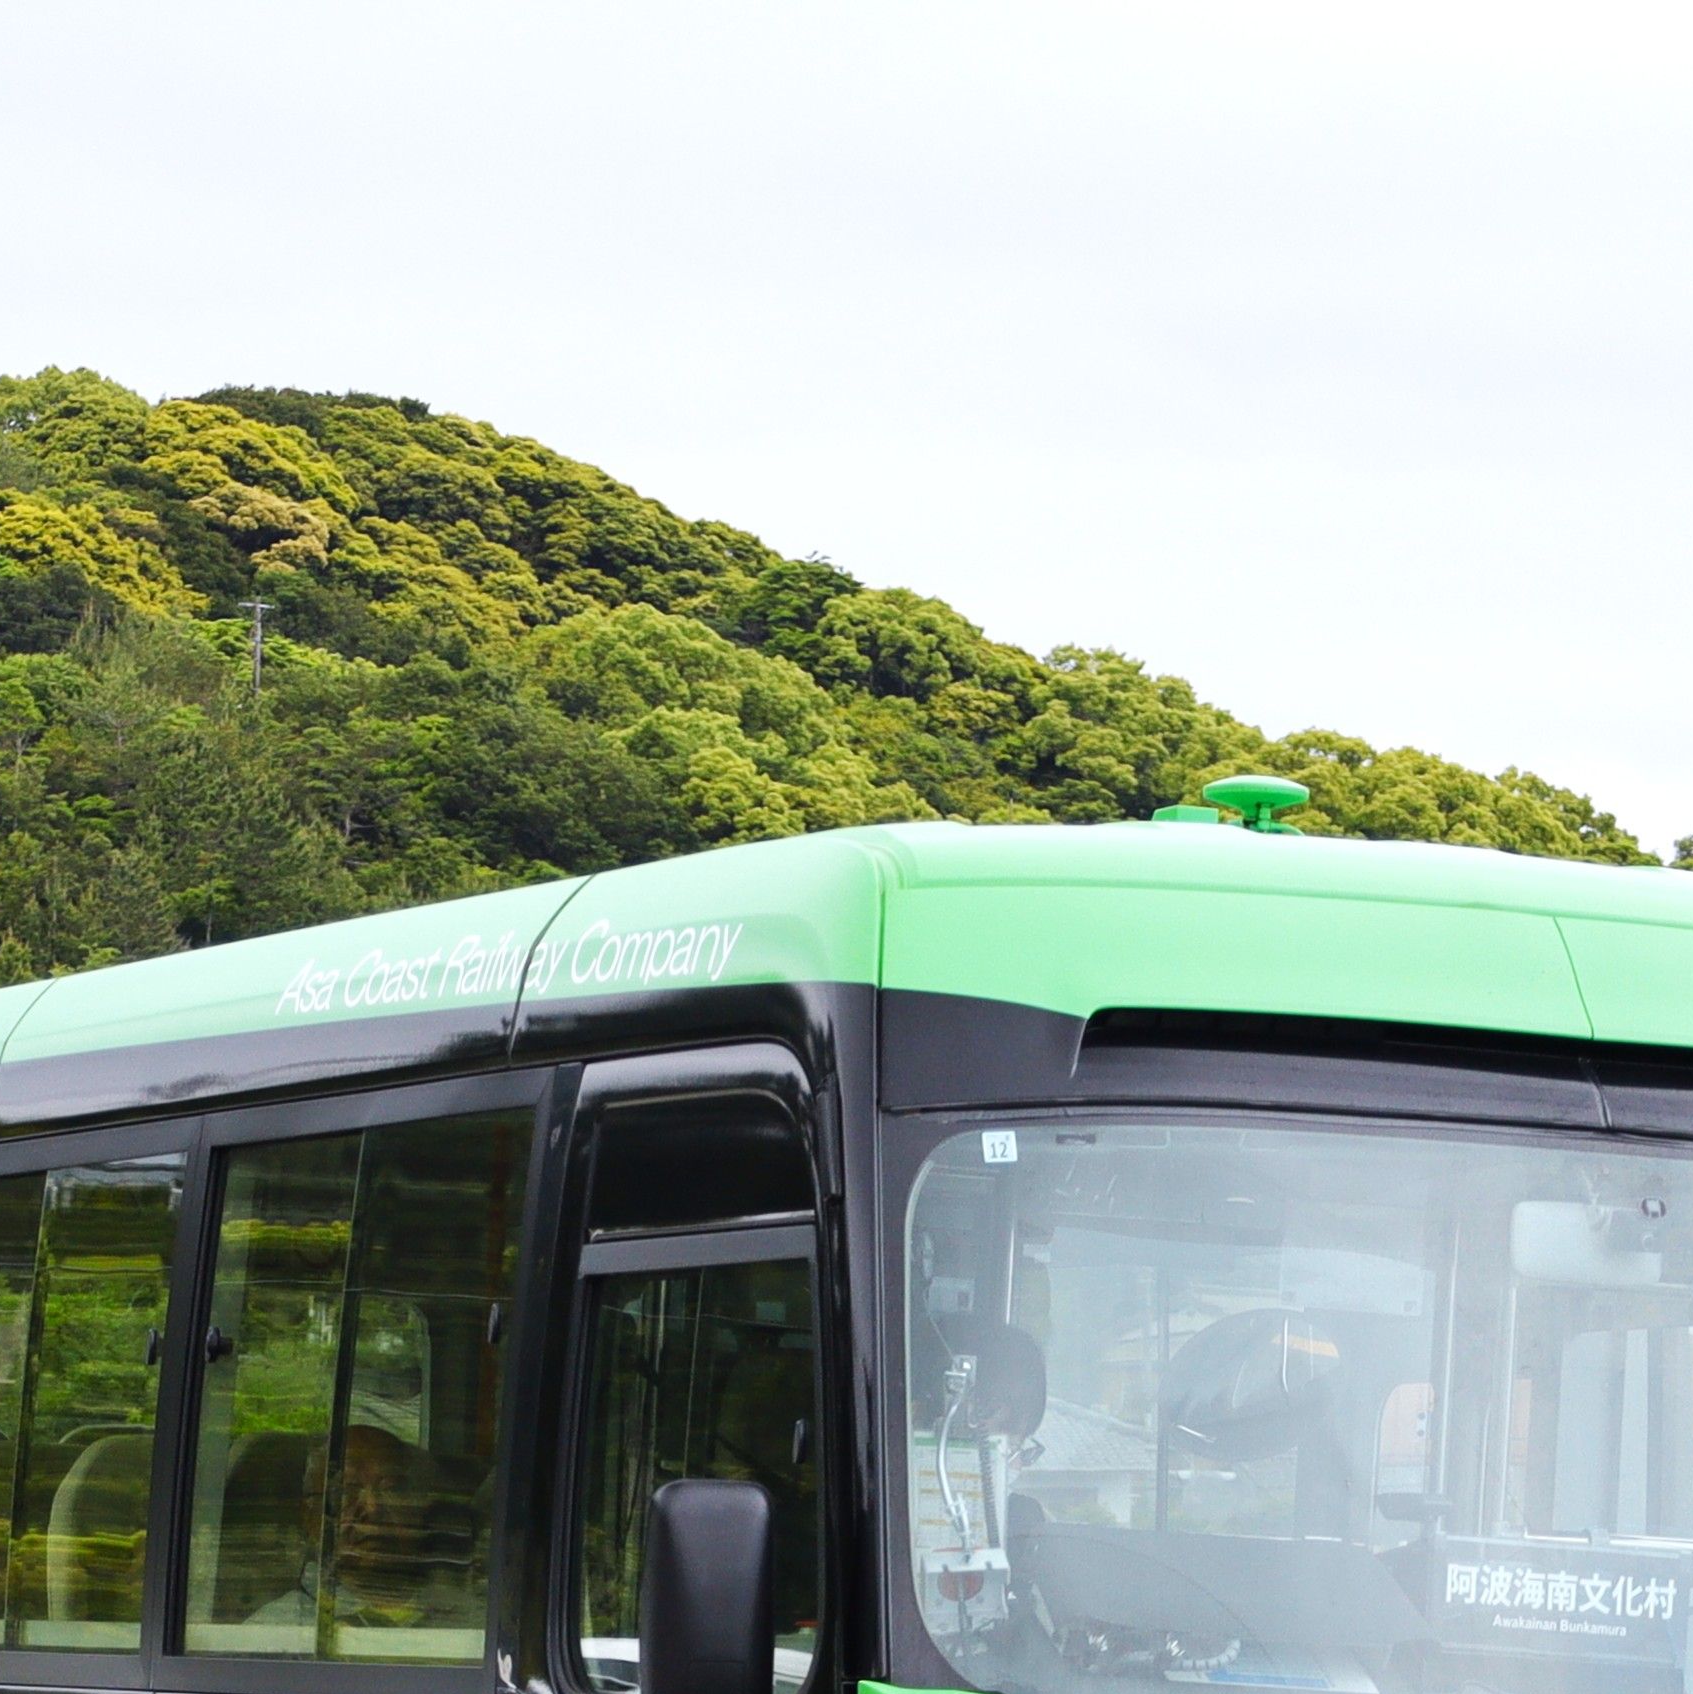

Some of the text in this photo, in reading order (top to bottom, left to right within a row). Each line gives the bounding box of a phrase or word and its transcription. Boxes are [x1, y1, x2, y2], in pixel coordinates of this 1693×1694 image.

[275, 919, 744, 1016] Asa Coast Railway Company
[990, 1141, 1009, 1160] 12
[1445, 1562, 1677, 1621] 阿波海南文化村
[1492, 1613, 1627, 1637] Awakainan Bunkamura
